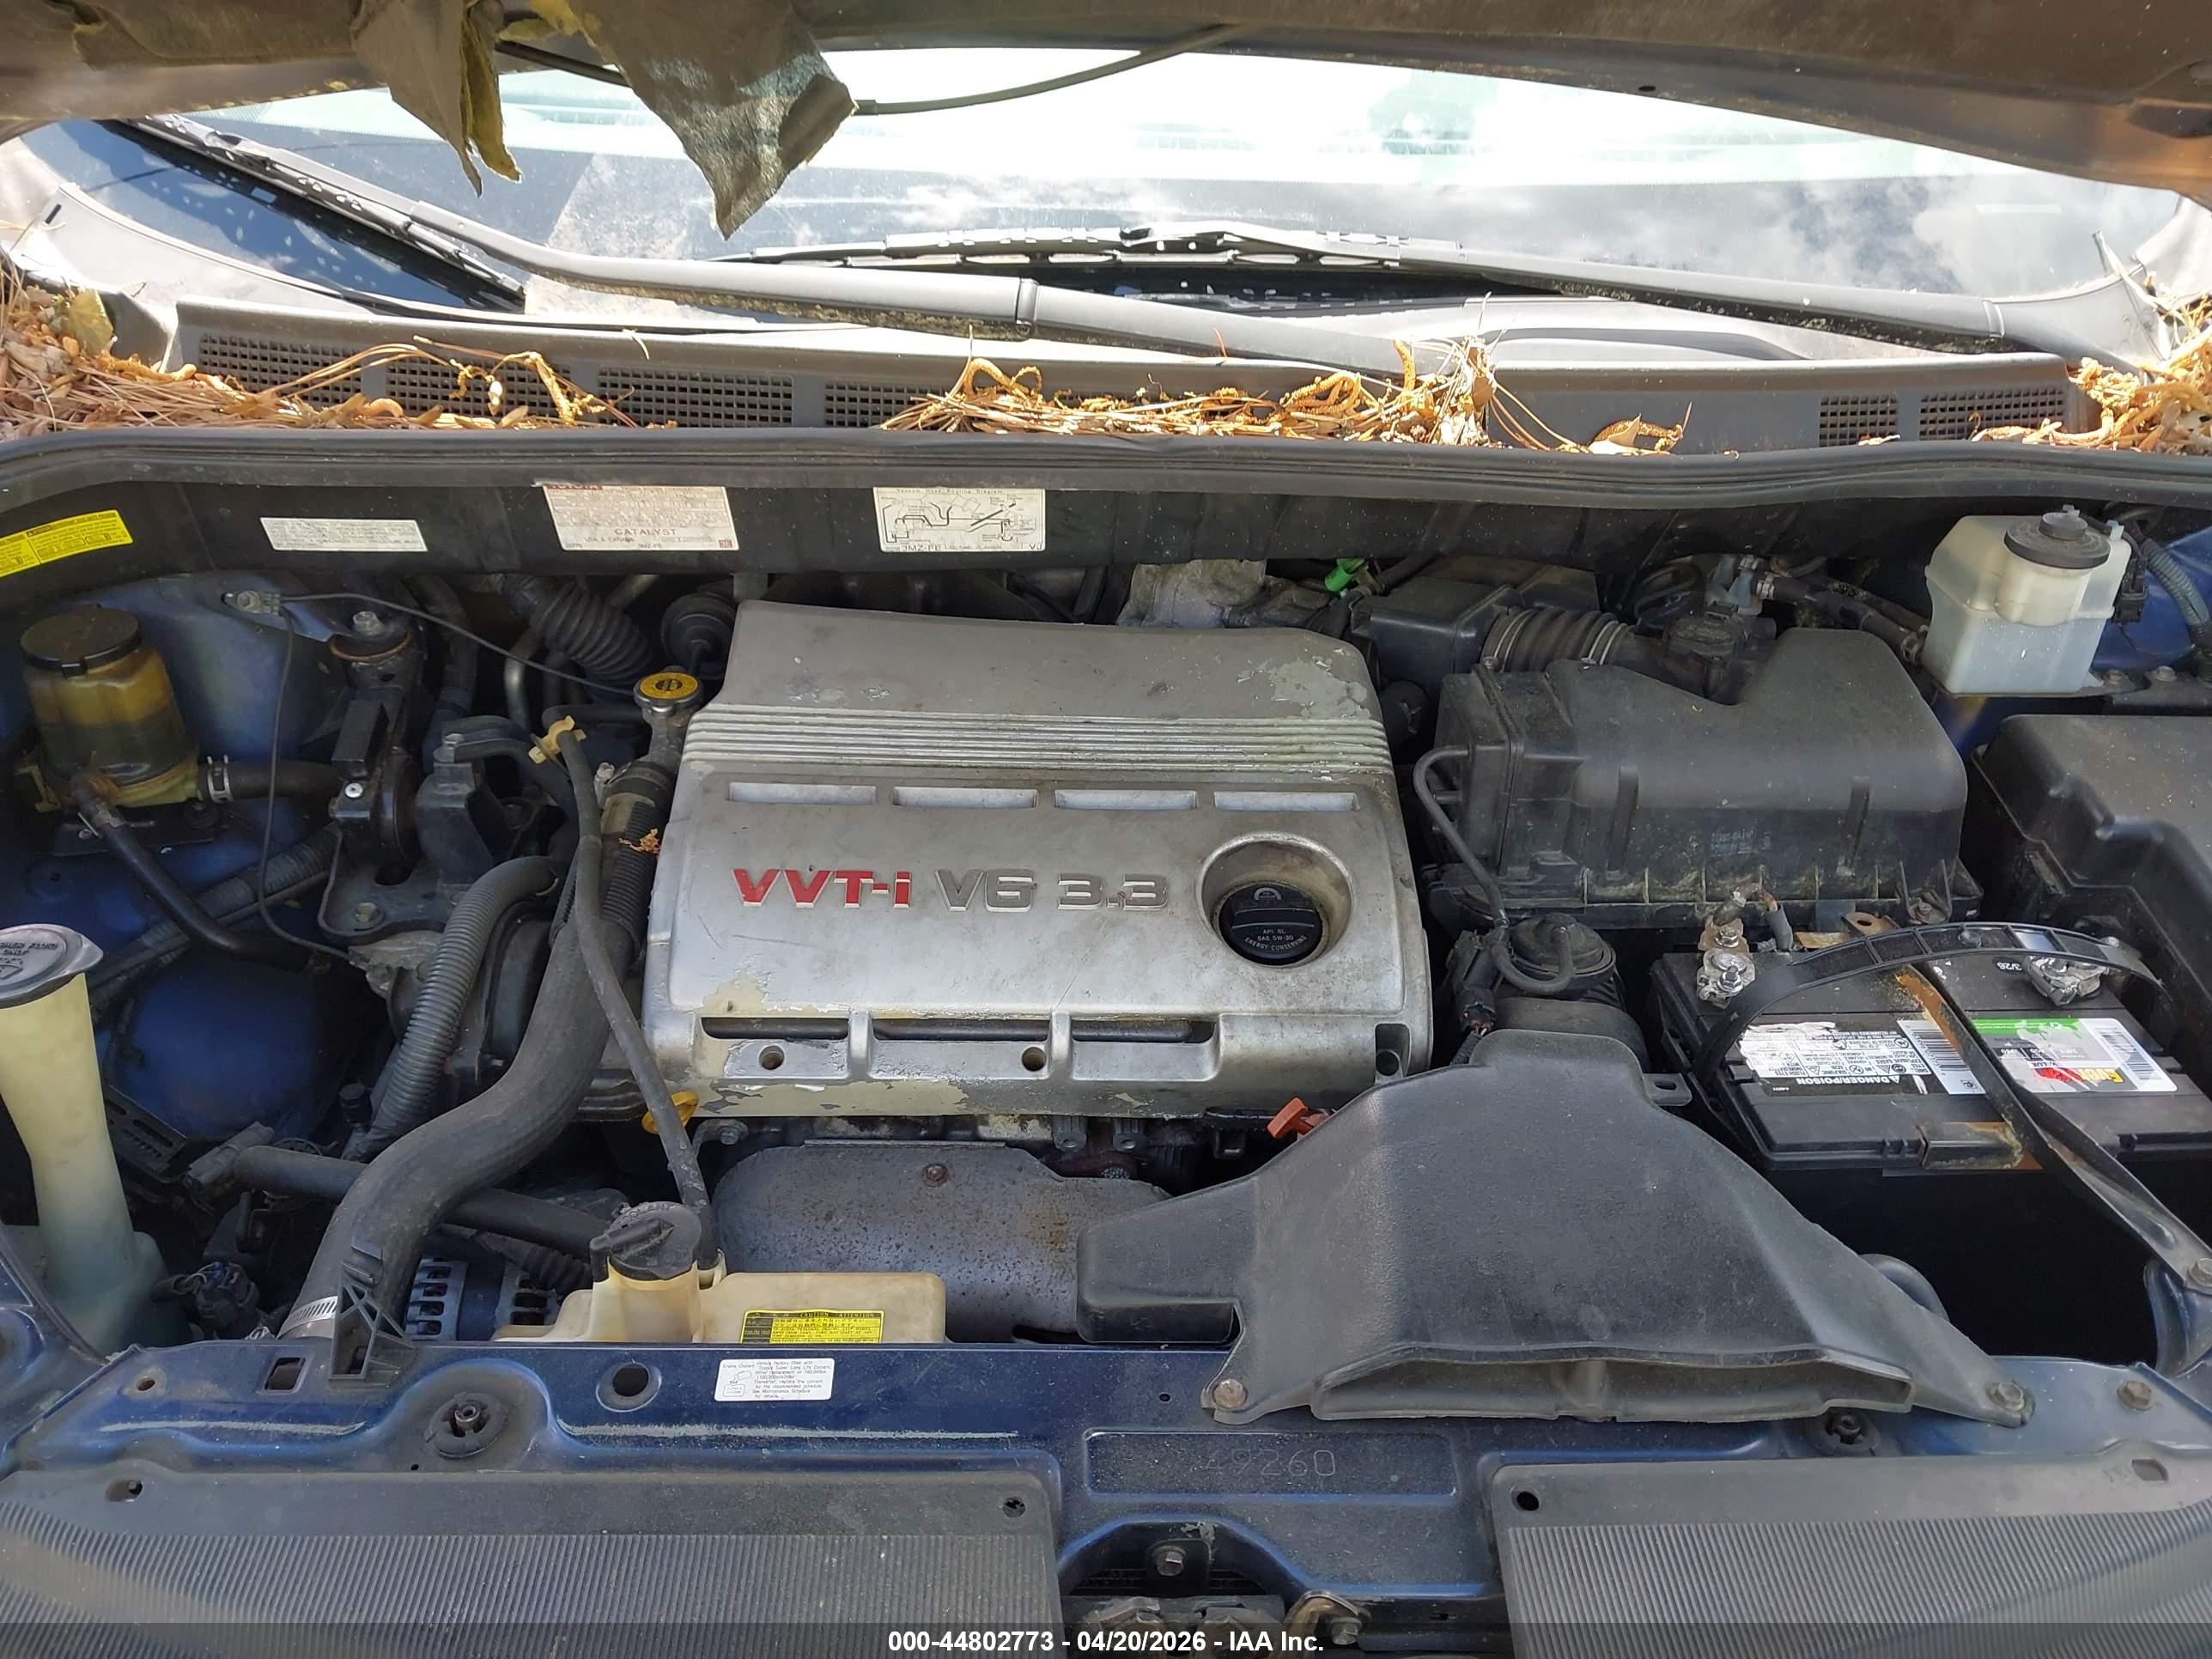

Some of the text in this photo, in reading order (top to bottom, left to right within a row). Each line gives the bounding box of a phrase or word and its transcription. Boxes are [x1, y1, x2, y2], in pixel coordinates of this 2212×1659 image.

[731, 867, 1168, 912] VVT-i V6 3.3
[1796, 1074, 1891, 1085] DANGER/POISON
